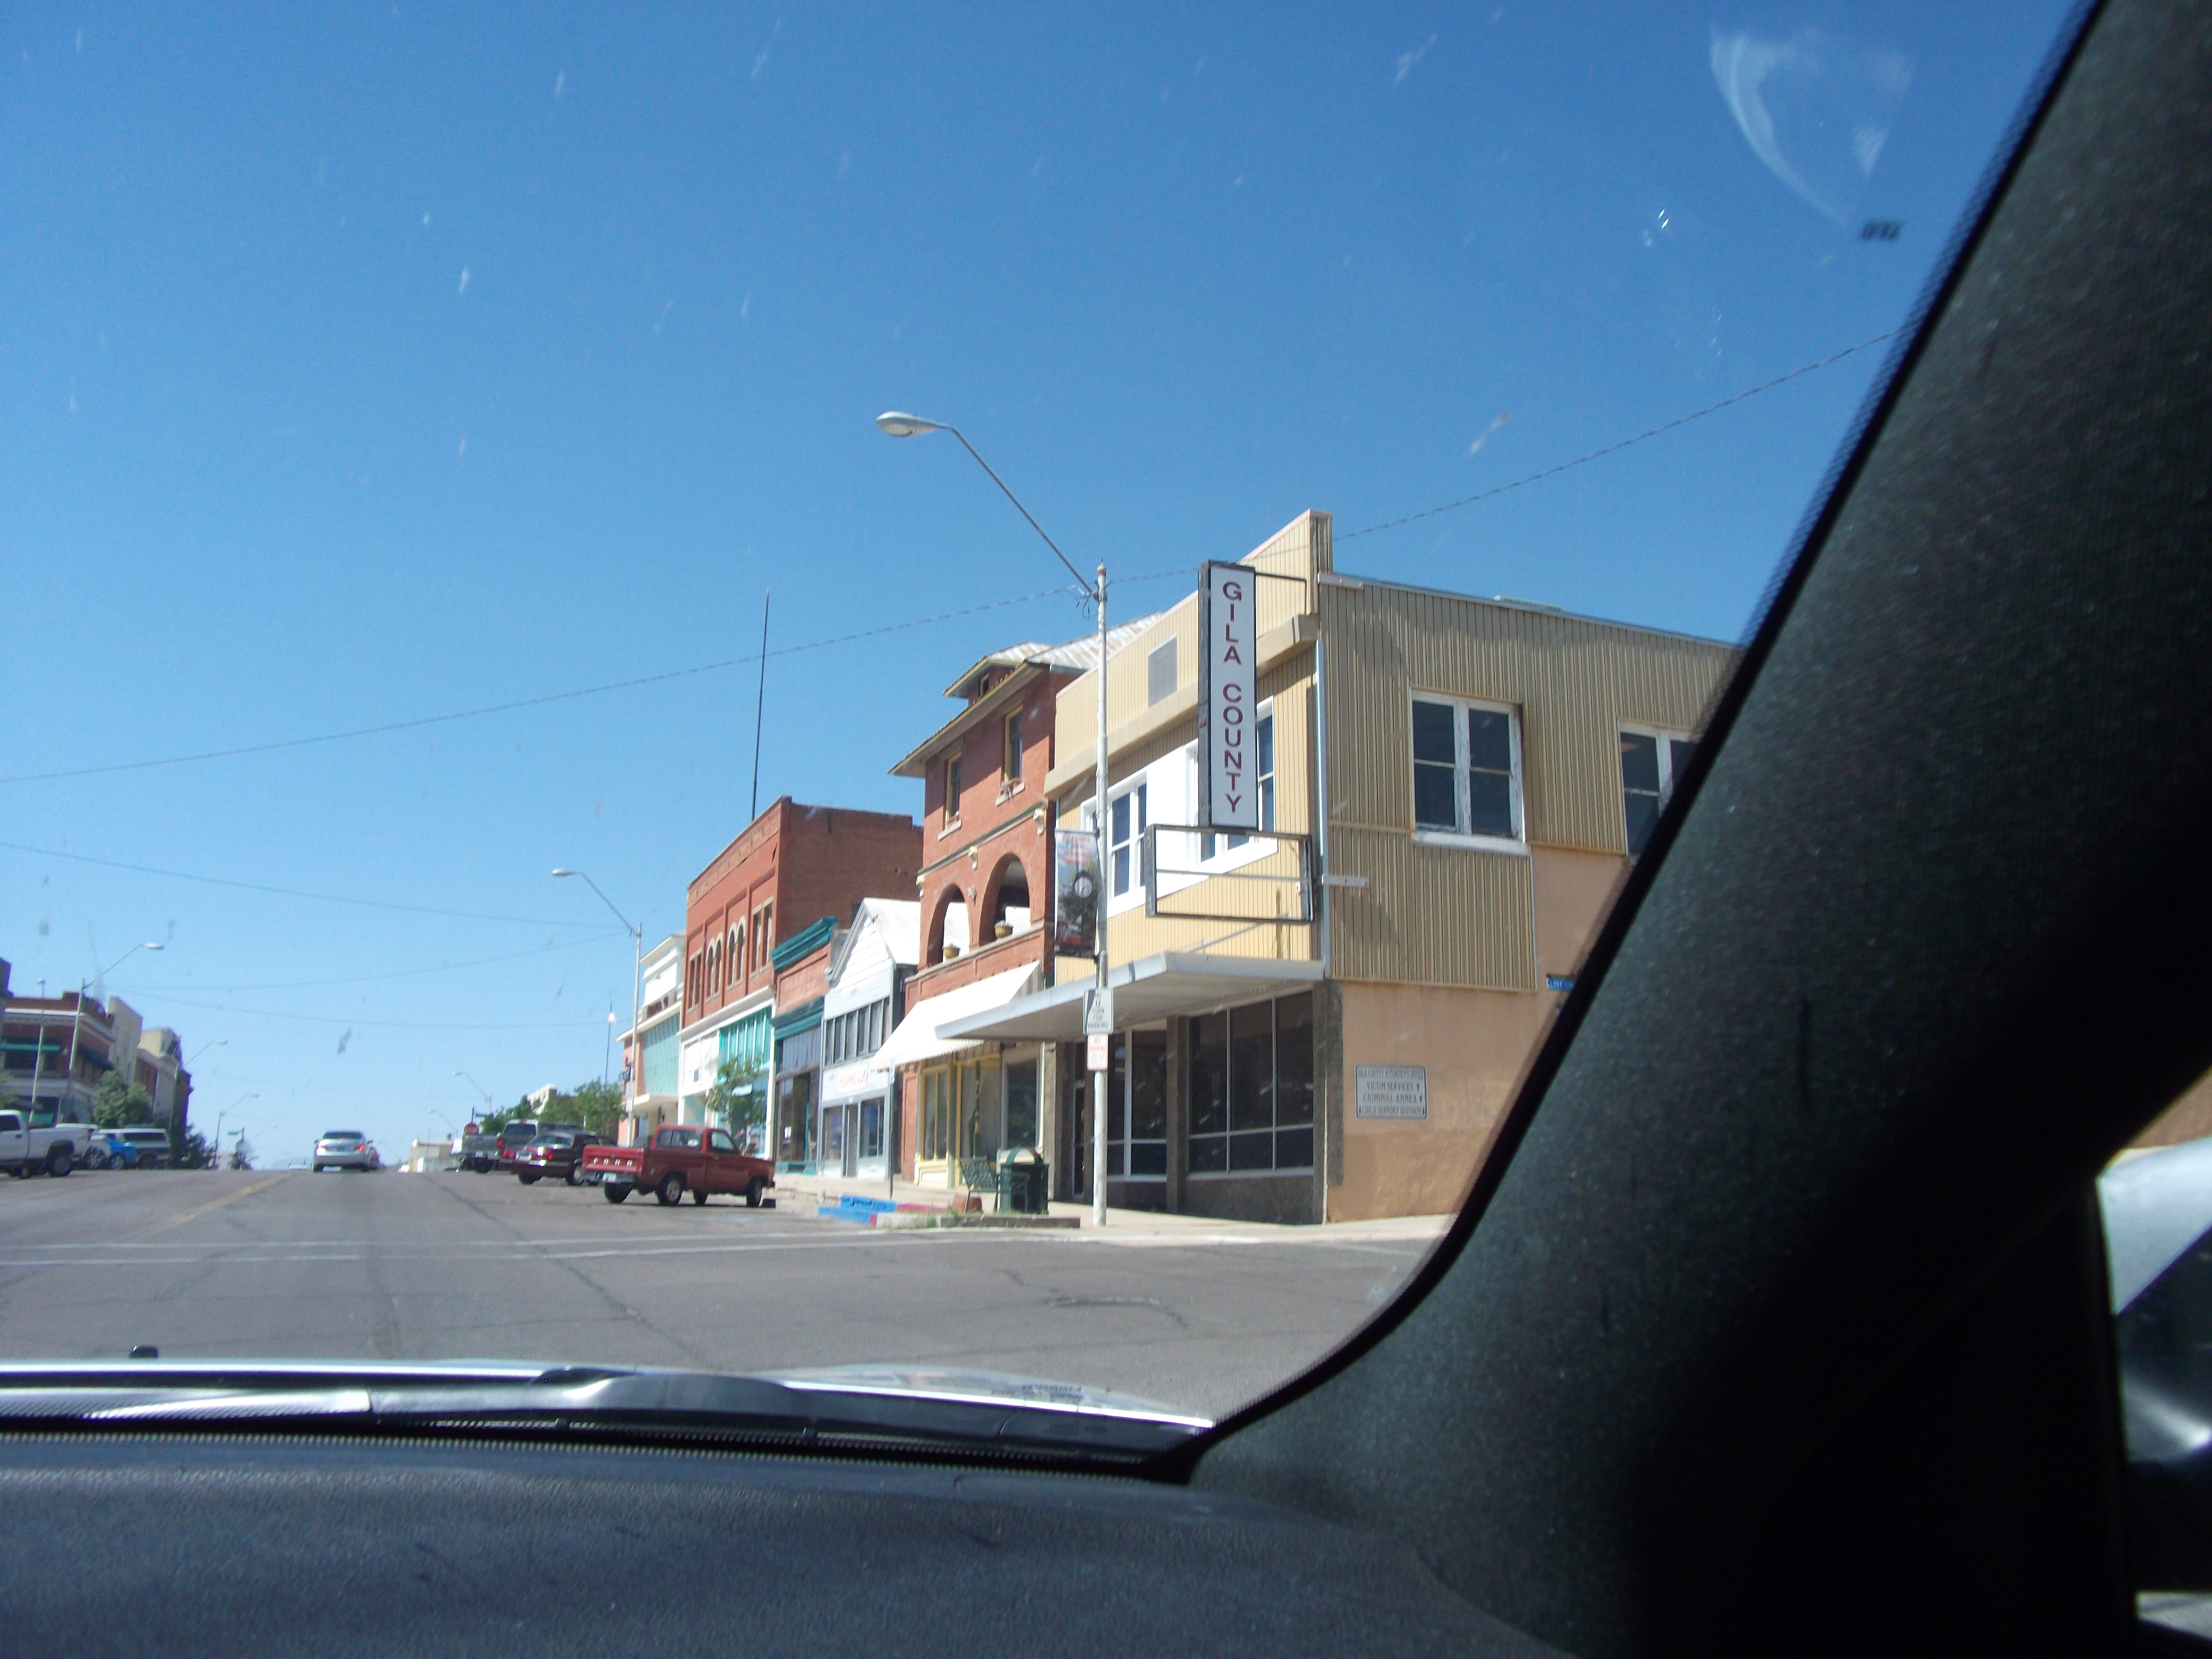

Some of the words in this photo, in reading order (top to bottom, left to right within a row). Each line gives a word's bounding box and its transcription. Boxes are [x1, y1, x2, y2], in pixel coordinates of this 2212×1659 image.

[1223, 581, 1242, 665] GILA
[1223, 684, 1243, 813] COUNTY
[1366, 1081, 1385, 1091] VICTIM
[1386, 1082, 1413, 1092] SERVICES
[1363, 1094, 1392, 1103] CRIMINAL
[1396, 1094, 1417, 1104] ANNEX
[593, 1157, 633, 1167] FORD
